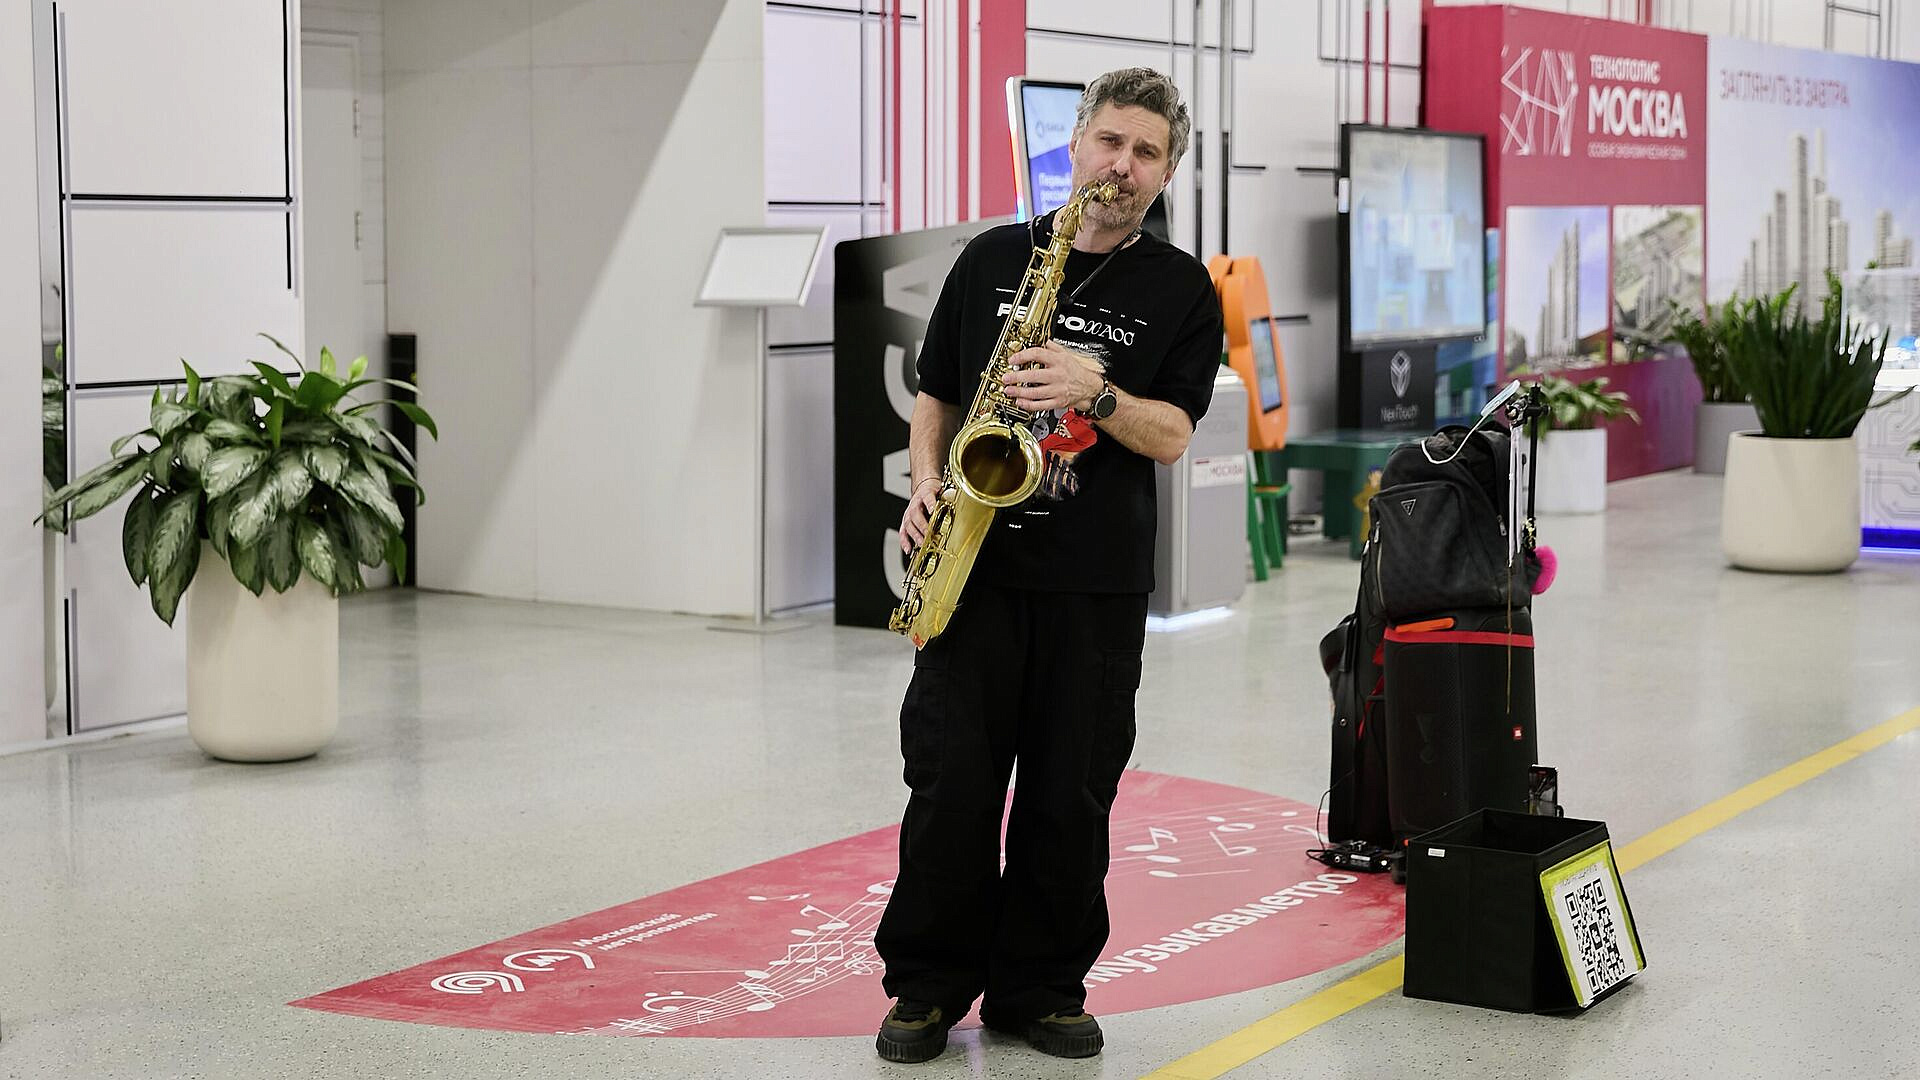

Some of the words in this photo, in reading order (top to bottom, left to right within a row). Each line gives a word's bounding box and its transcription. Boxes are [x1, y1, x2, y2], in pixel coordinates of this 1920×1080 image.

[1590, 54, 1660, 84] ТЕХНОПОЛИС
[1588, 84, 1689, 139] МОСКВА
[572, 913, 682, 947] Московский
[597, 912, 719, 951] метрополитен
[1083, 872, 1358, 988] музыкавметро
